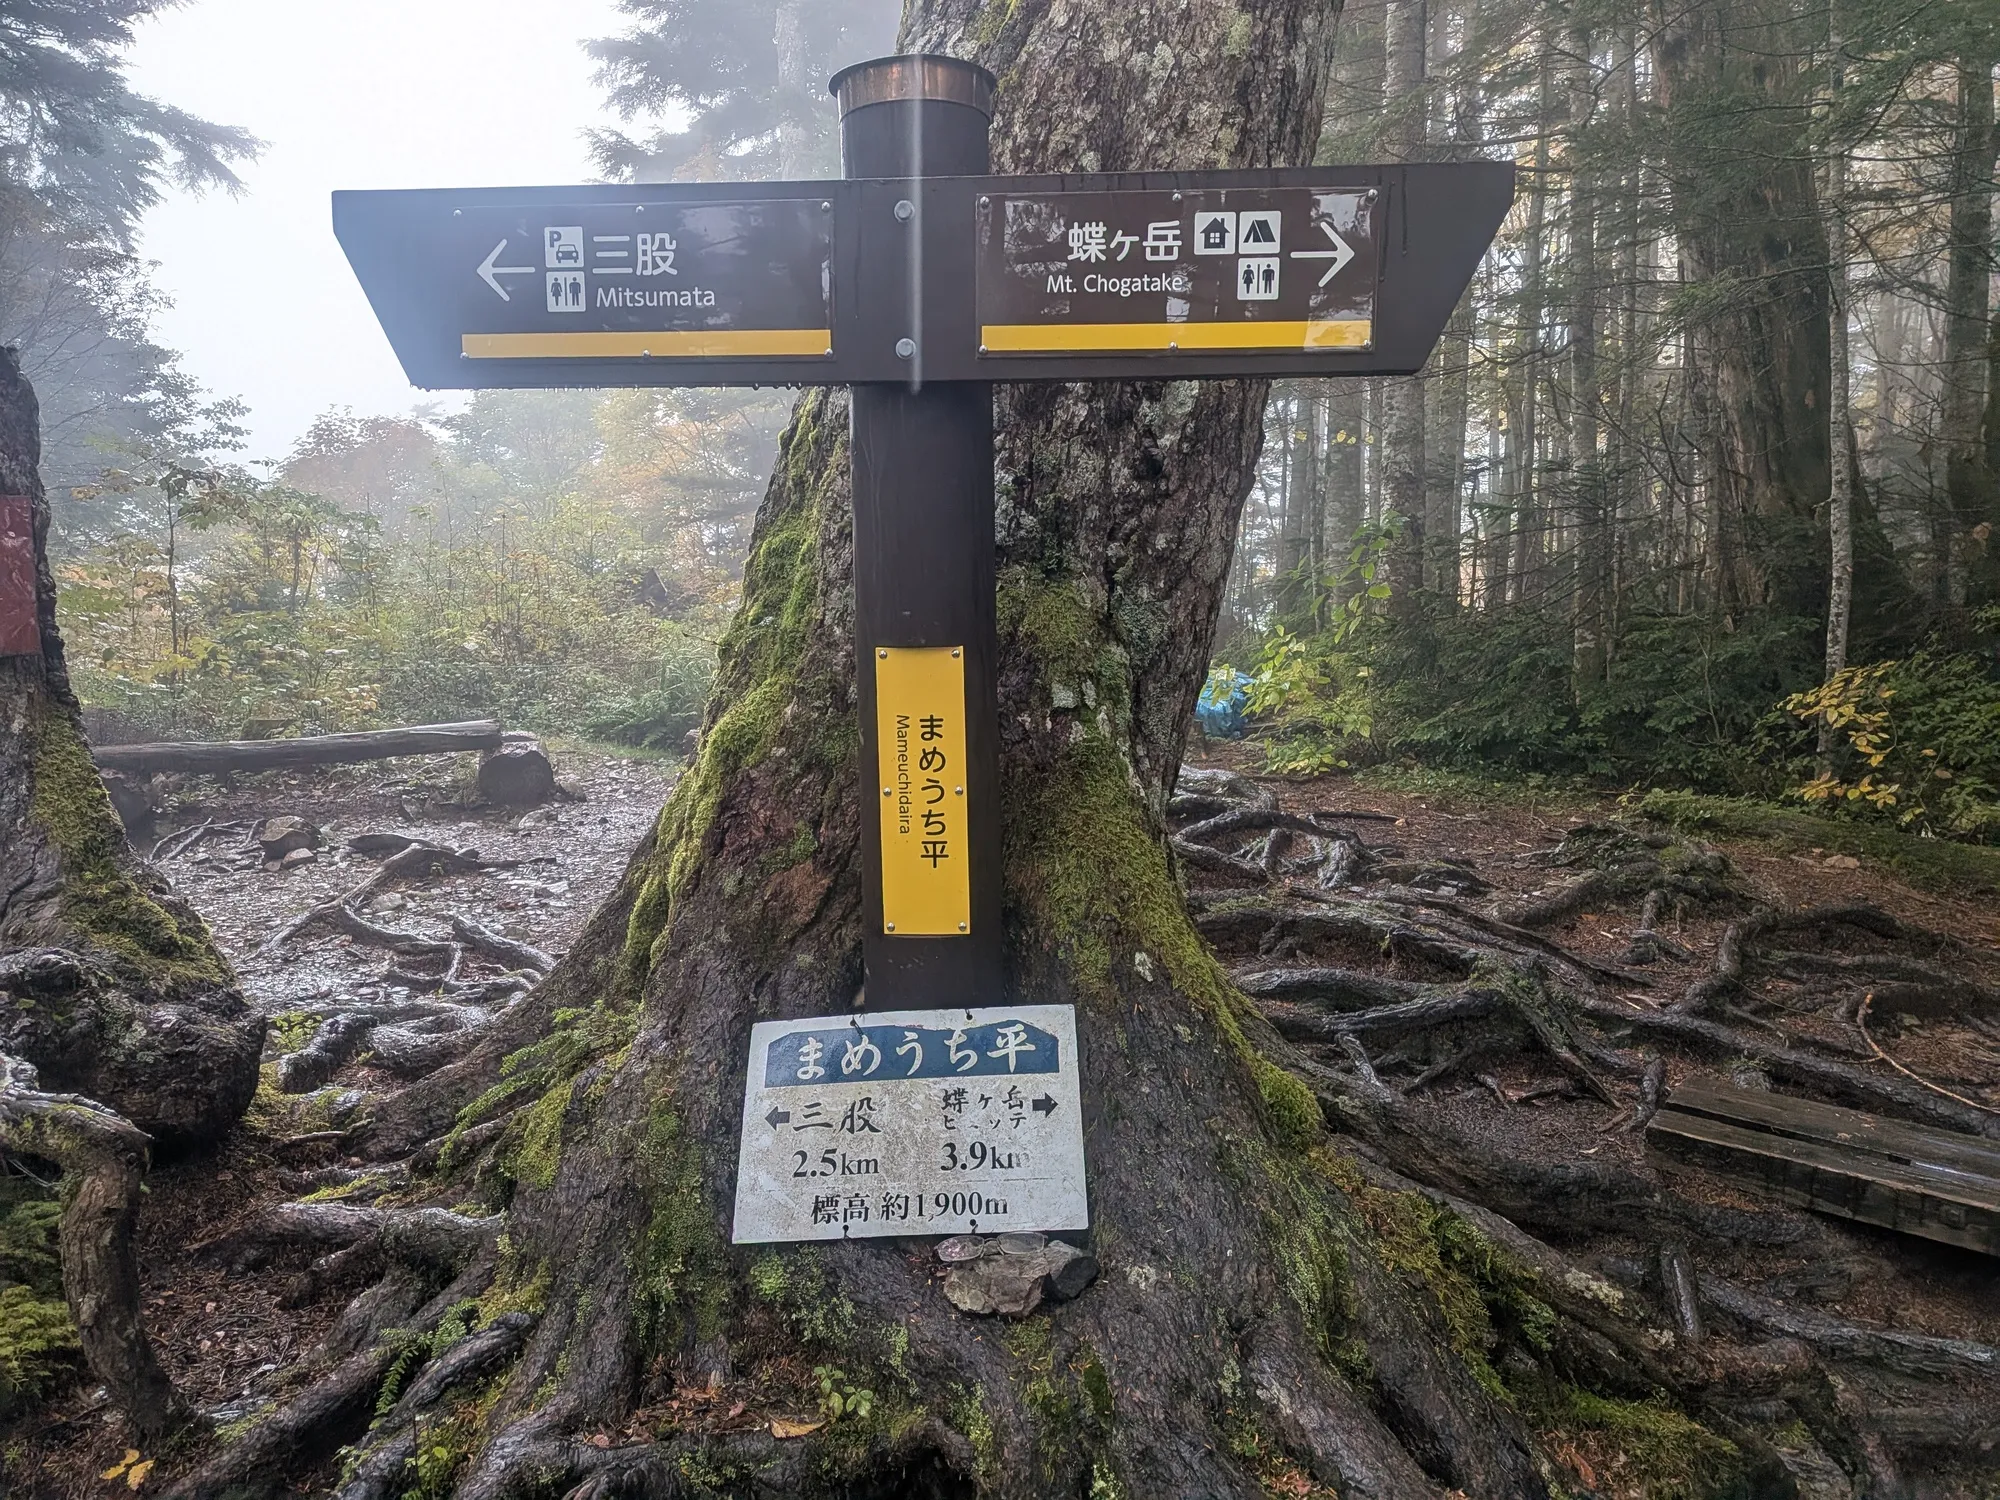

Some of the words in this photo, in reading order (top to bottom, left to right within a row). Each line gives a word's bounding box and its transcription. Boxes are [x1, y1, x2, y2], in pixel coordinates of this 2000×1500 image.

[591, 231, 679, 278] 三股
[1067, 219, 1183, 263] 蝶ヶ岳
[595, 285, 716, 309] Mitsumata
[1045, 273, 1078, 294] Mt.
[1082, 271, 1183, 298] Chogatake
[895, 714, 913, 834] Mameuchidaira
[918, 714, 950, 869] まめうち平
[795, 1022, 1037, 1080] まめうち平
[791, 1096, 883, 1135] 三股
[791, 1149, 880, 1179] 2.5km
[811, 1193, 870, 1226] 標高
